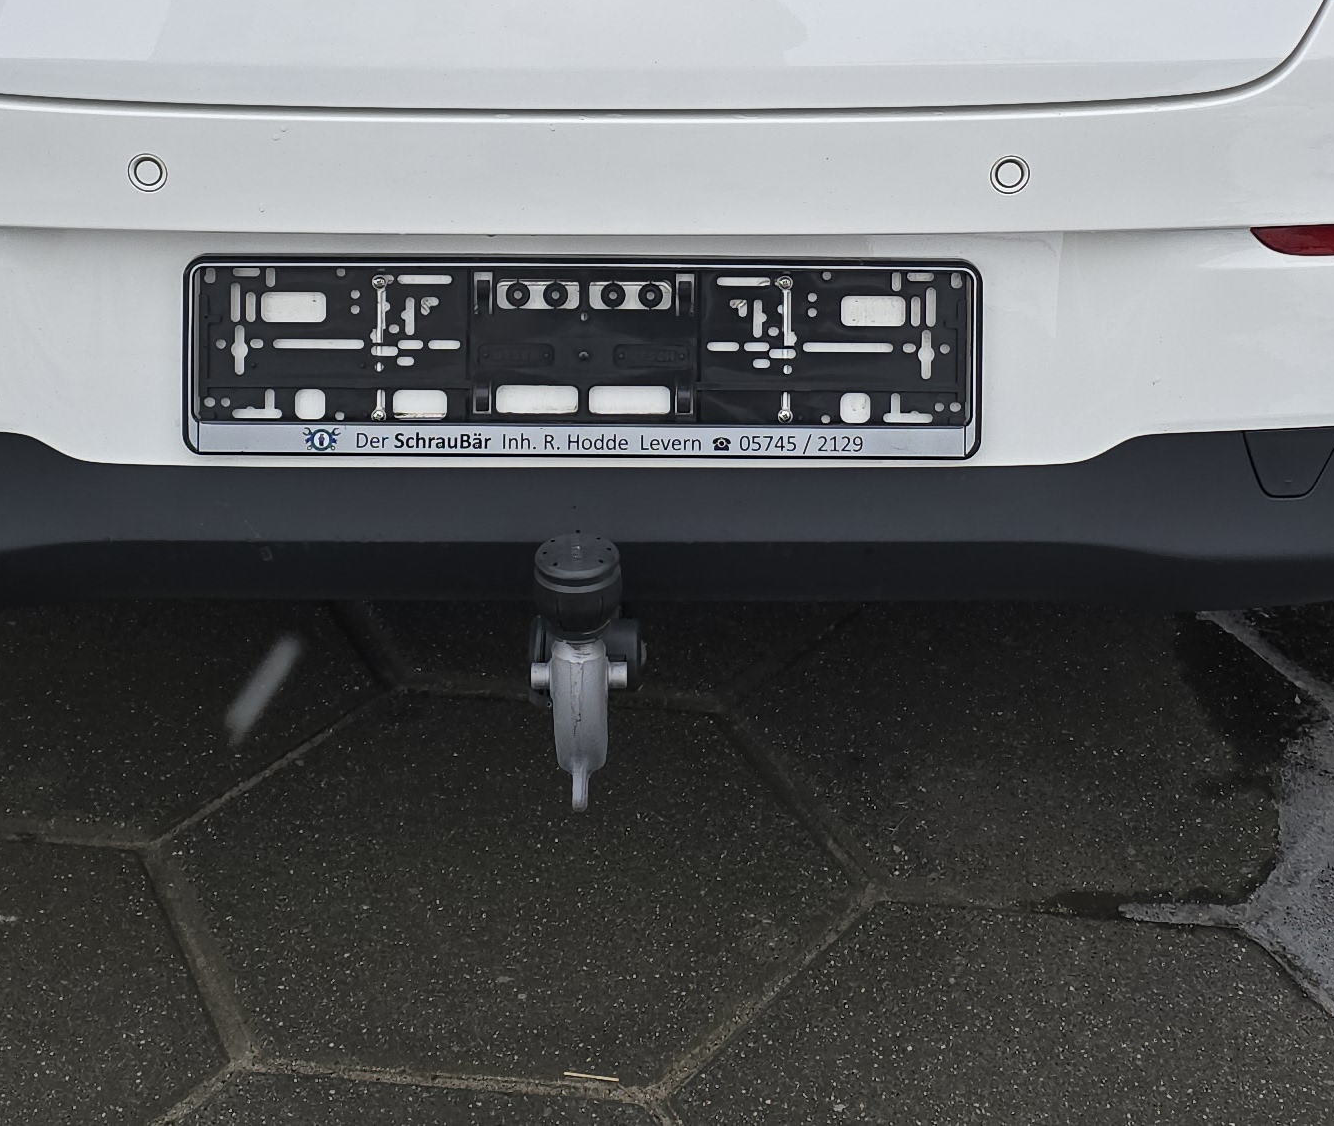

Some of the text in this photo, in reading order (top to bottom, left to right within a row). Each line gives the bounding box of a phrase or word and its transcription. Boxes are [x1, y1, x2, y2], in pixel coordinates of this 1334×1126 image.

[355, 432, 864, 455] Der SchrauBär Inh. R. Hodde Levern 05745 / 2129
